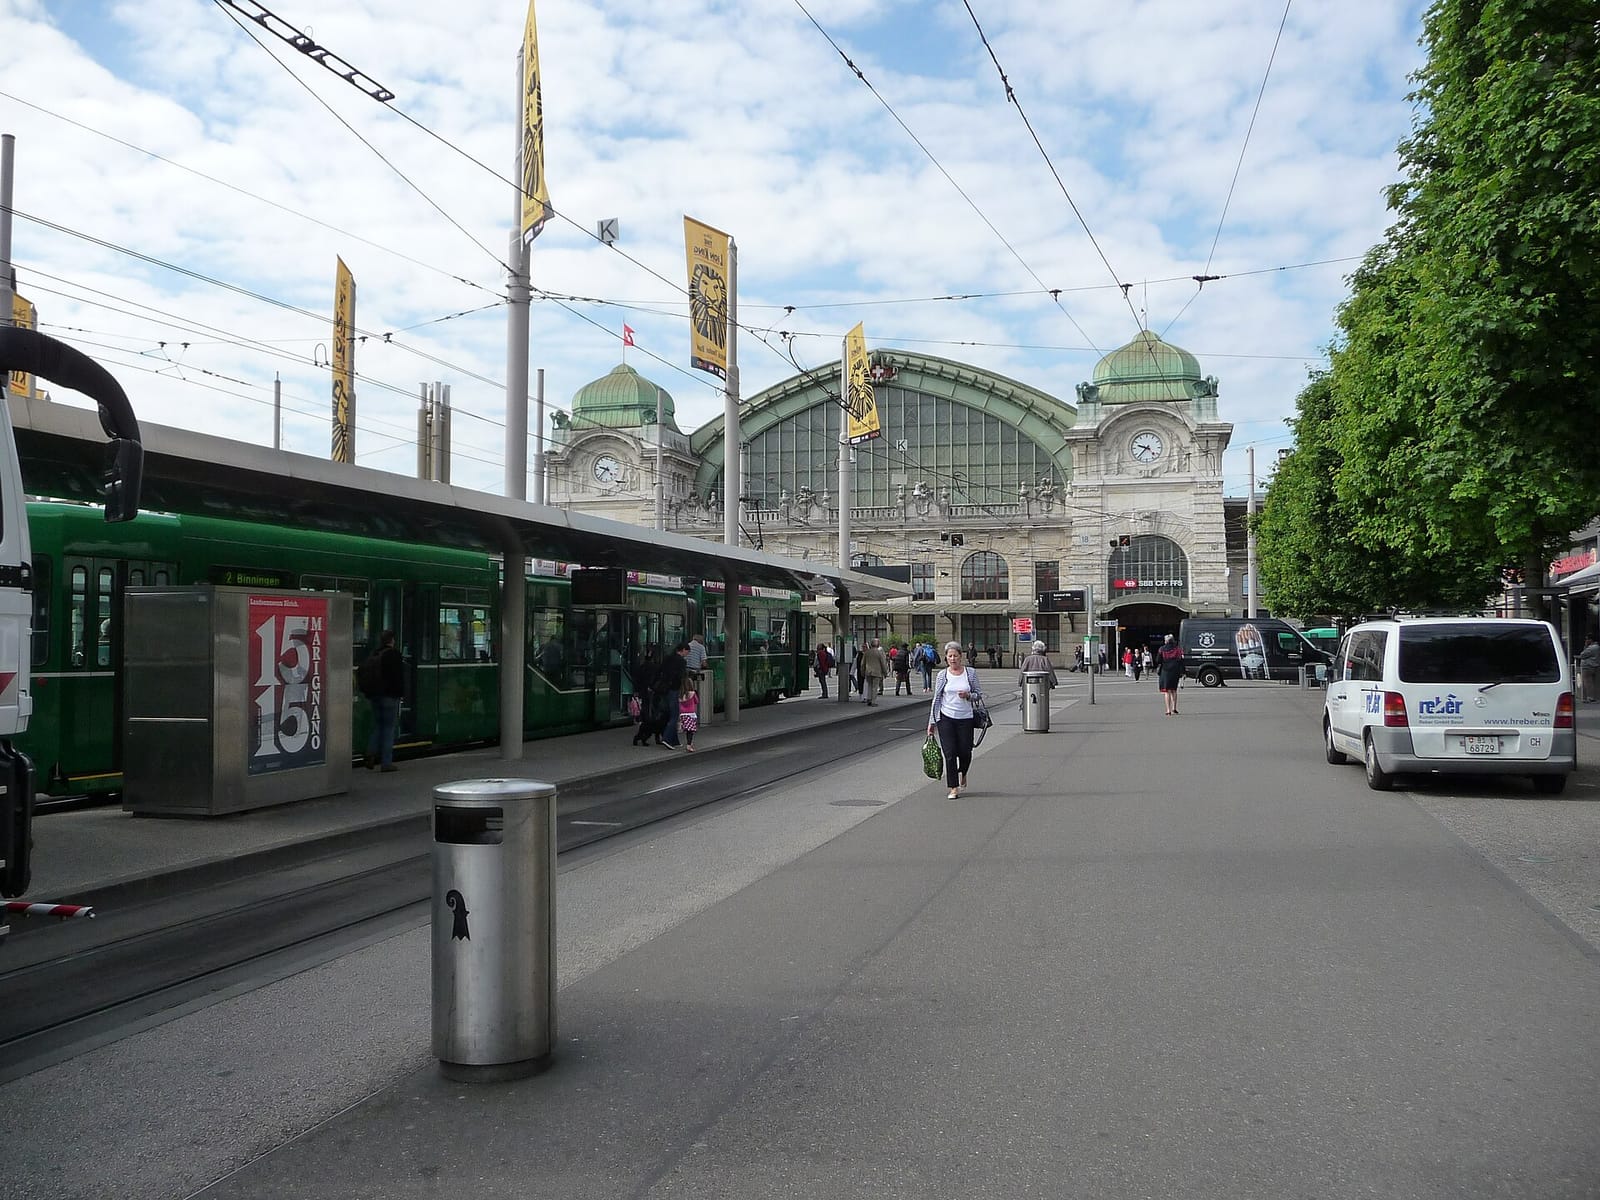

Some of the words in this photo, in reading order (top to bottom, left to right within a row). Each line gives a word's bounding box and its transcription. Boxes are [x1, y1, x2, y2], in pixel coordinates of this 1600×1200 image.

[600, 220, 616, 240] K
[897, 440, 906, 450] K
[225, 572, 233, 584] 2
[237, 574, 281, 586] Binningen
[254, 614, 310, 686] 15
[310, 617, 322, 750] MARIGNANO
[254, 683, 310, 757] 15
[1484, 717, 1551, 726] www.hreber.ch
[1469, 744, 1495, 753] 68729
[1530, 737, 1541, 747] CH
